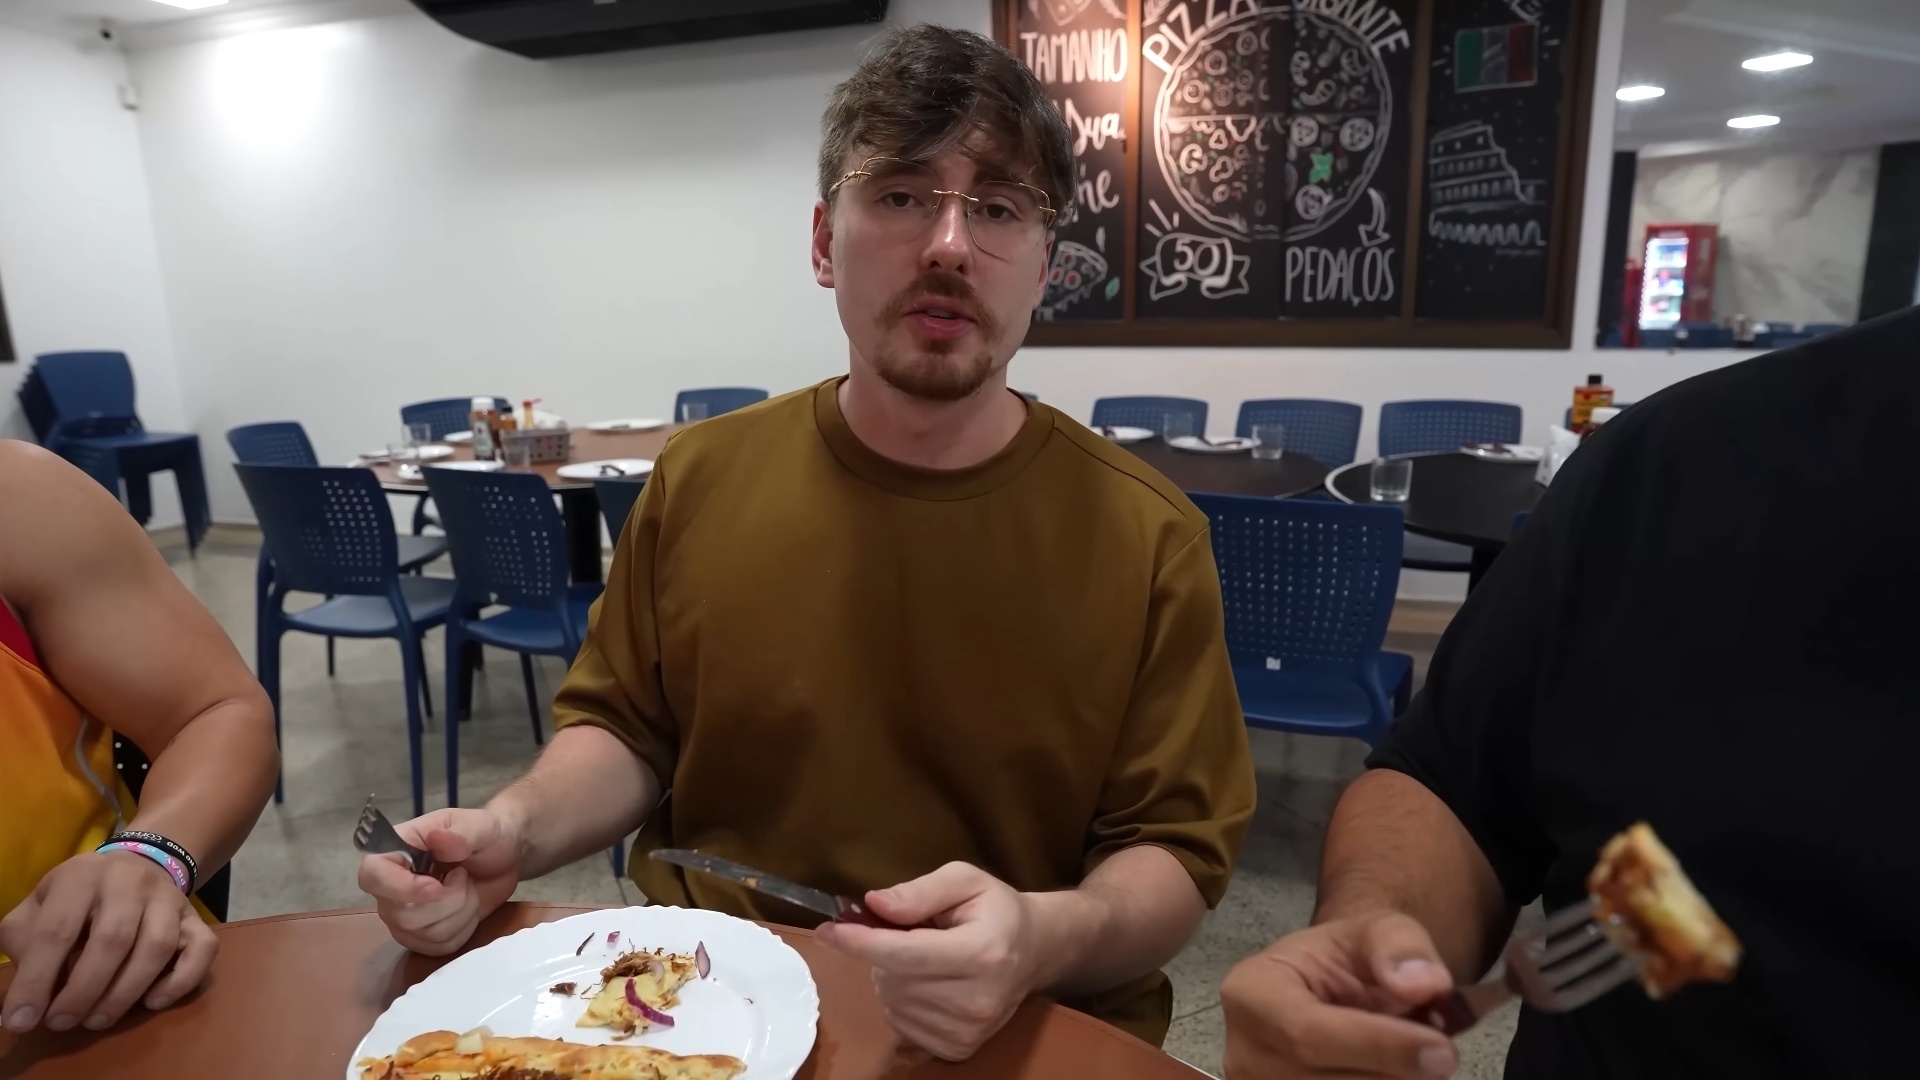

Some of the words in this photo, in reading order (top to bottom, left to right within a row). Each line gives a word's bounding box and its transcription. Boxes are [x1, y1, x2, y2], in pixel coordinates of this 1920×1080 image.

[1020, 28, 1128, 83] TAMANHO
[1173, 242, 1221, 276] 50
[1285, 246, 1395, 306] PEDAÇOS
